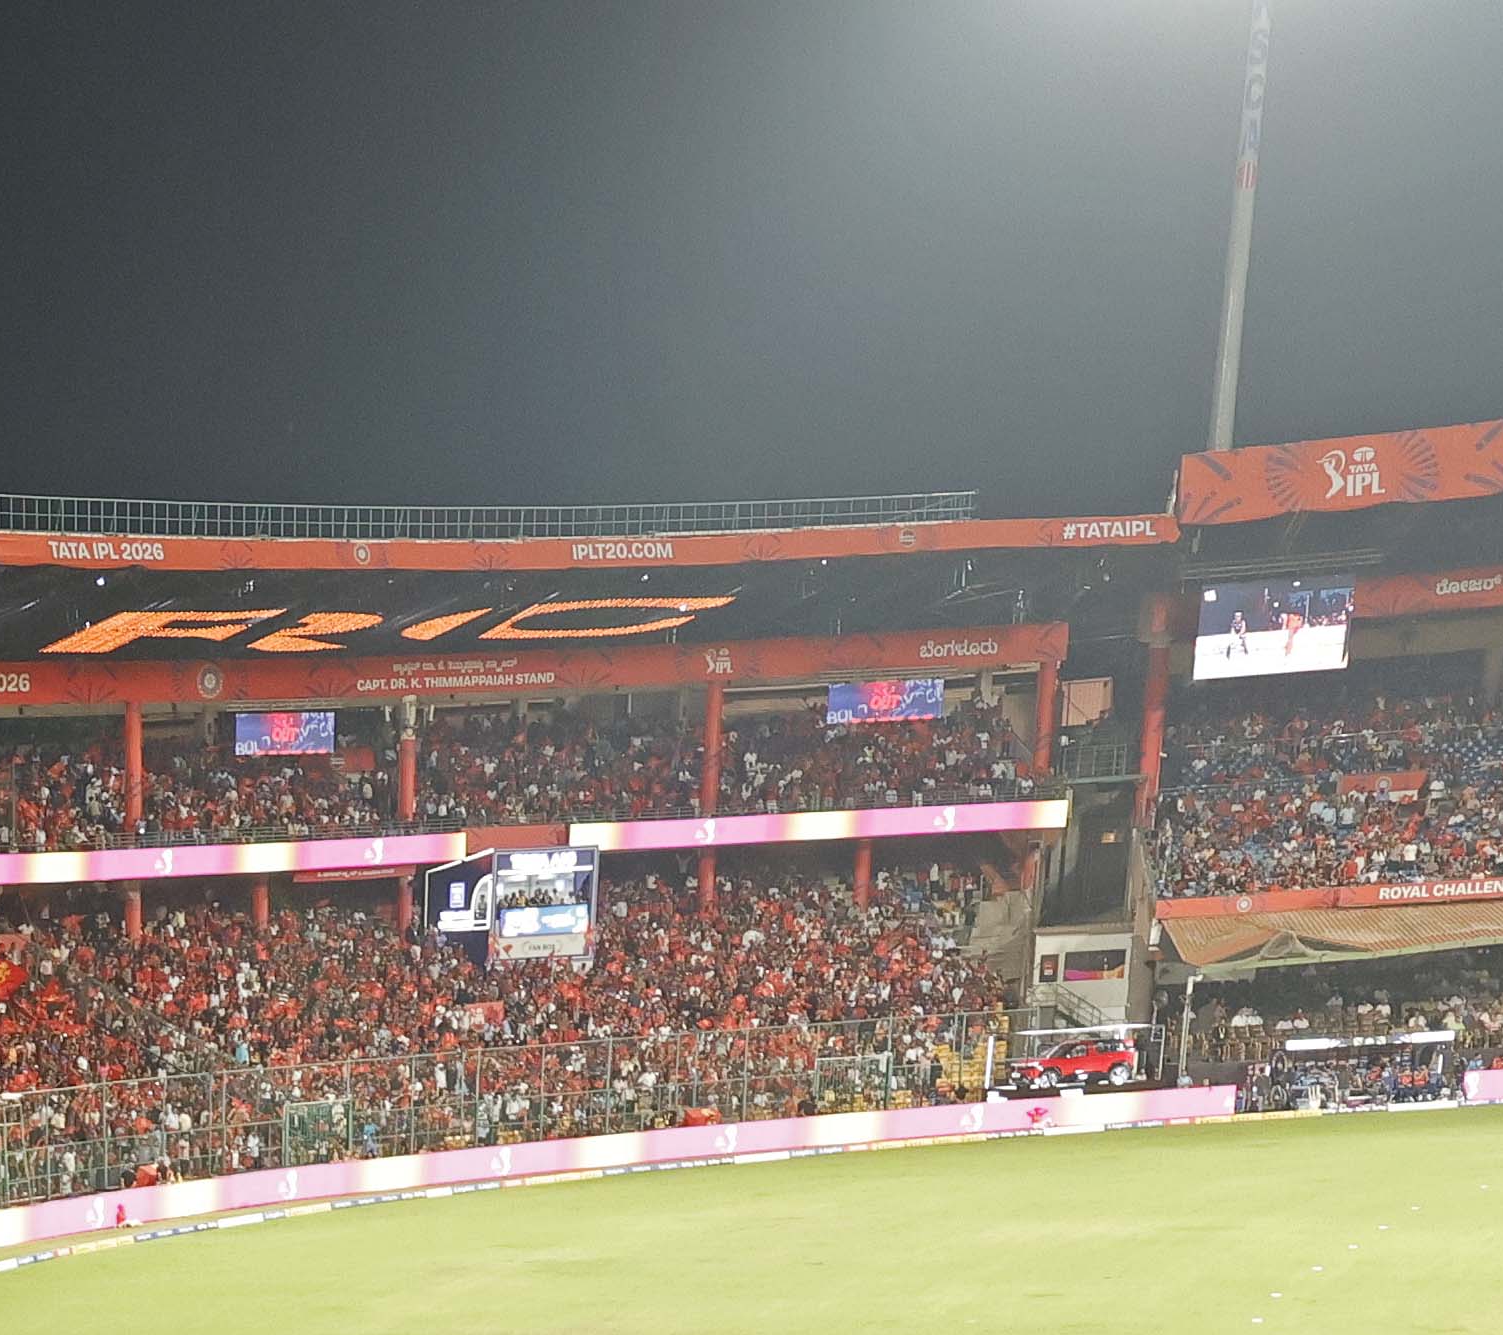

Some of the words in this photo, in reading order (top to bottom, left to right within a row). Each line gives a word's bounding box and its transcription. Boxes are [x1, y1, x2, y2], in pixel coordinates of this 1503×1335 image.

[1348, 462, 1378, 474] TATA
[1346, 472, 1386, 497] IPL
[1062, 520, 1157, 540] #TATAIPL
[48, 540, 93, 560] TATA
[93, 541, 120, 560] IPL
[120, 541, 165, 561] 2026
[572, 542, 675, 561] IPLT20.COM
[357, 678, 390, 692] CAPT.
[390, 677, 410, 691] DR.
[411, 677, 423, 690] K.
[515, 671, 556, 686] STAND
[1378, 883, 1430, 901] ROYAL
